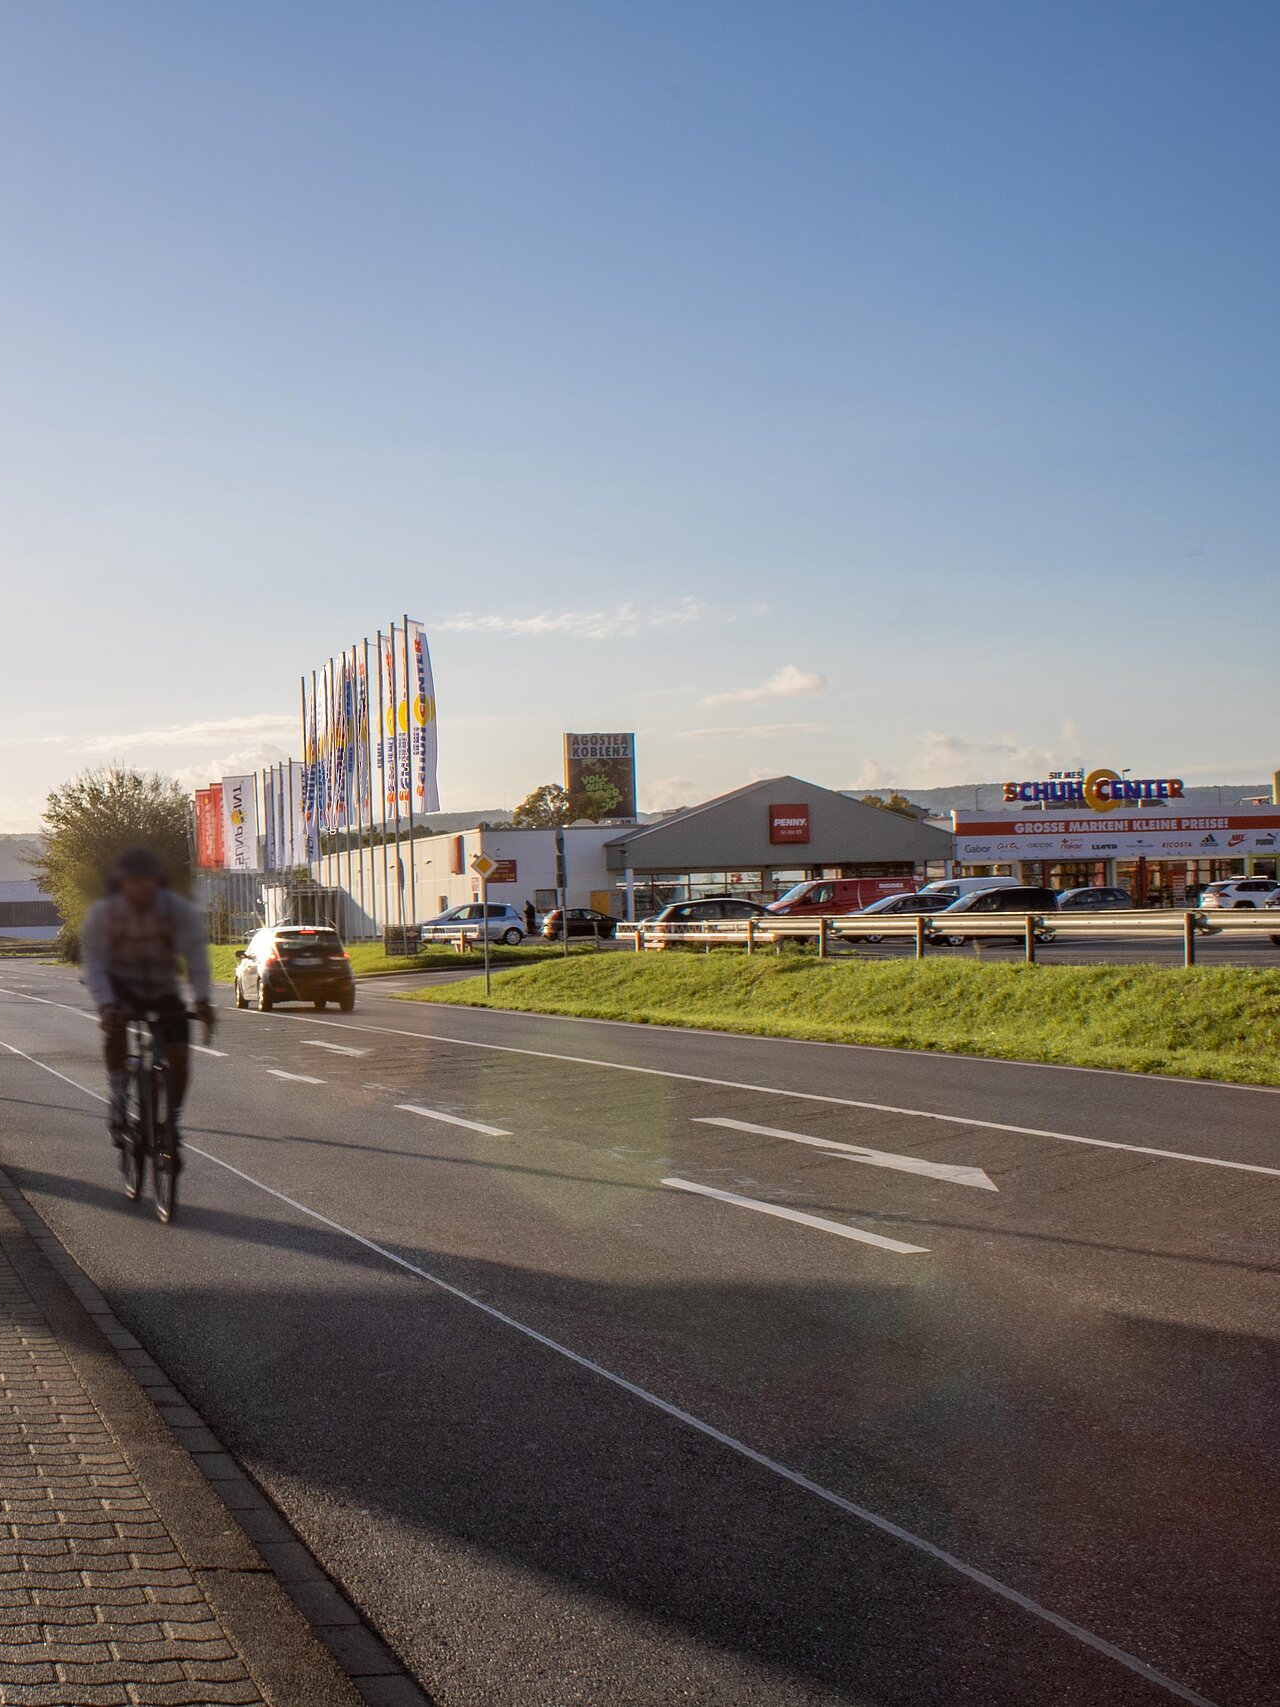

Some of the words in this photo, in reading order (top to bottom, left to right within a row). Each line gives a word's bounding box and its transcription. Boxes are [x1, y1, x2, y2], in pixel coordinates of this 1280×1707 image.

[572, 735, 628, 746] AGOSTEA
[572, 746, 629, 758] KOBLENZ
[1003, 781, 1084, 802] SCHUH
[1093, 778, 1185, 803] CENTER
[1014, 822, 1066, 834] GROSSE
[1069, 819, 1129, 833] MARKEN!
[1132, 818, 1178, 831] KLEINE
[1181, 817, 1229, 830] PREISE!
[964, 844, 991, 854] Gabor
[996, 842, 1020, 850] ara
[1161, 841, 1193, 849] RICOSTA
